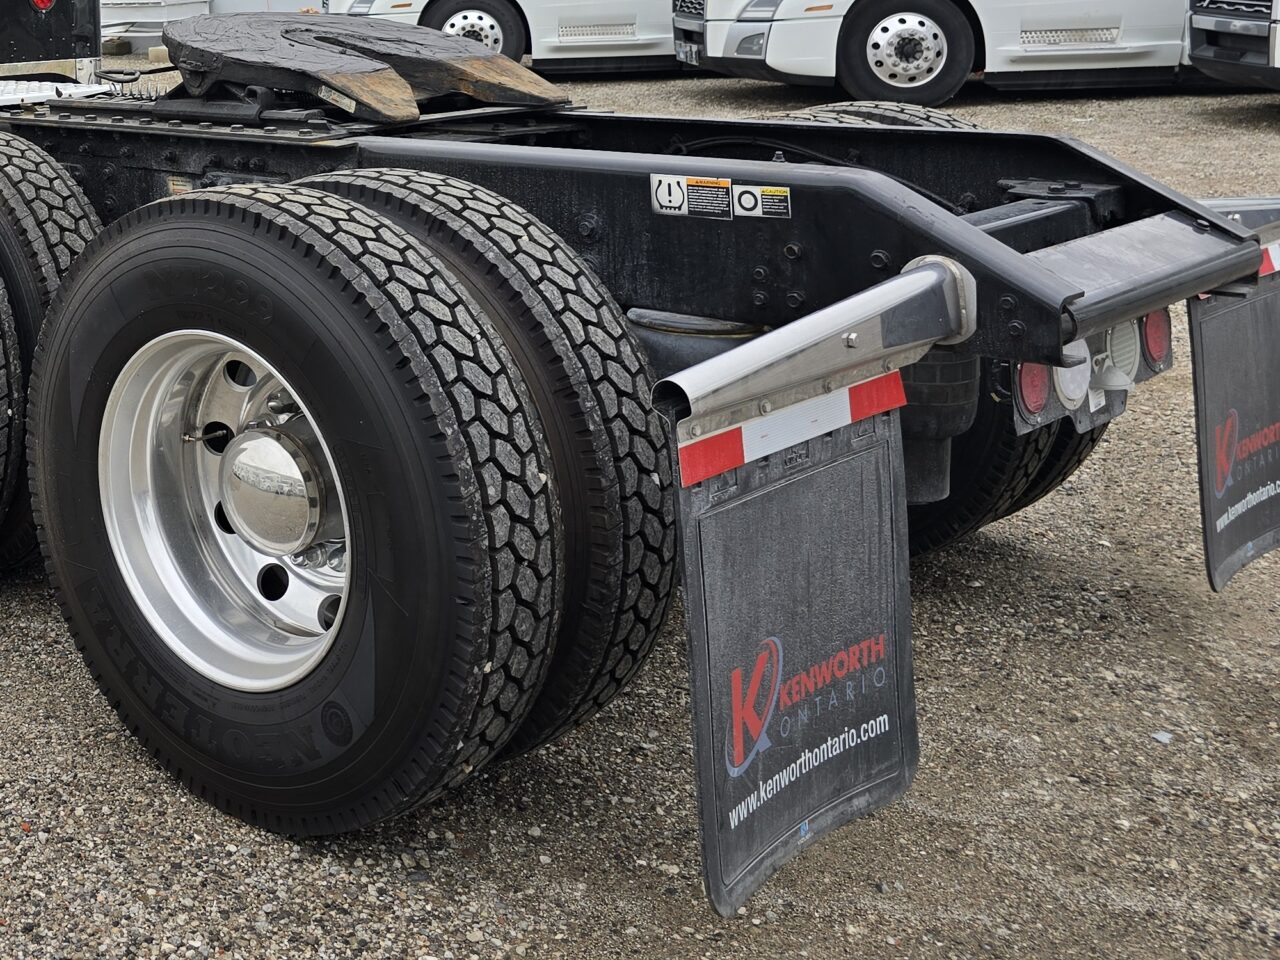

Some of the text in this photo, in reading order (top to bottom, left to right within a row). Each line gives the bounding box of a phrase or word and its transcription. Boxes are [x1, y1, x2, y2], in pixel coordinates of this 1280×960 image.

[778, 634, 887, 711] KENWORTH
[779, 667, 886, 738] ONTARIO
[728, 713, 889, 830] www.kenworthontario.com
